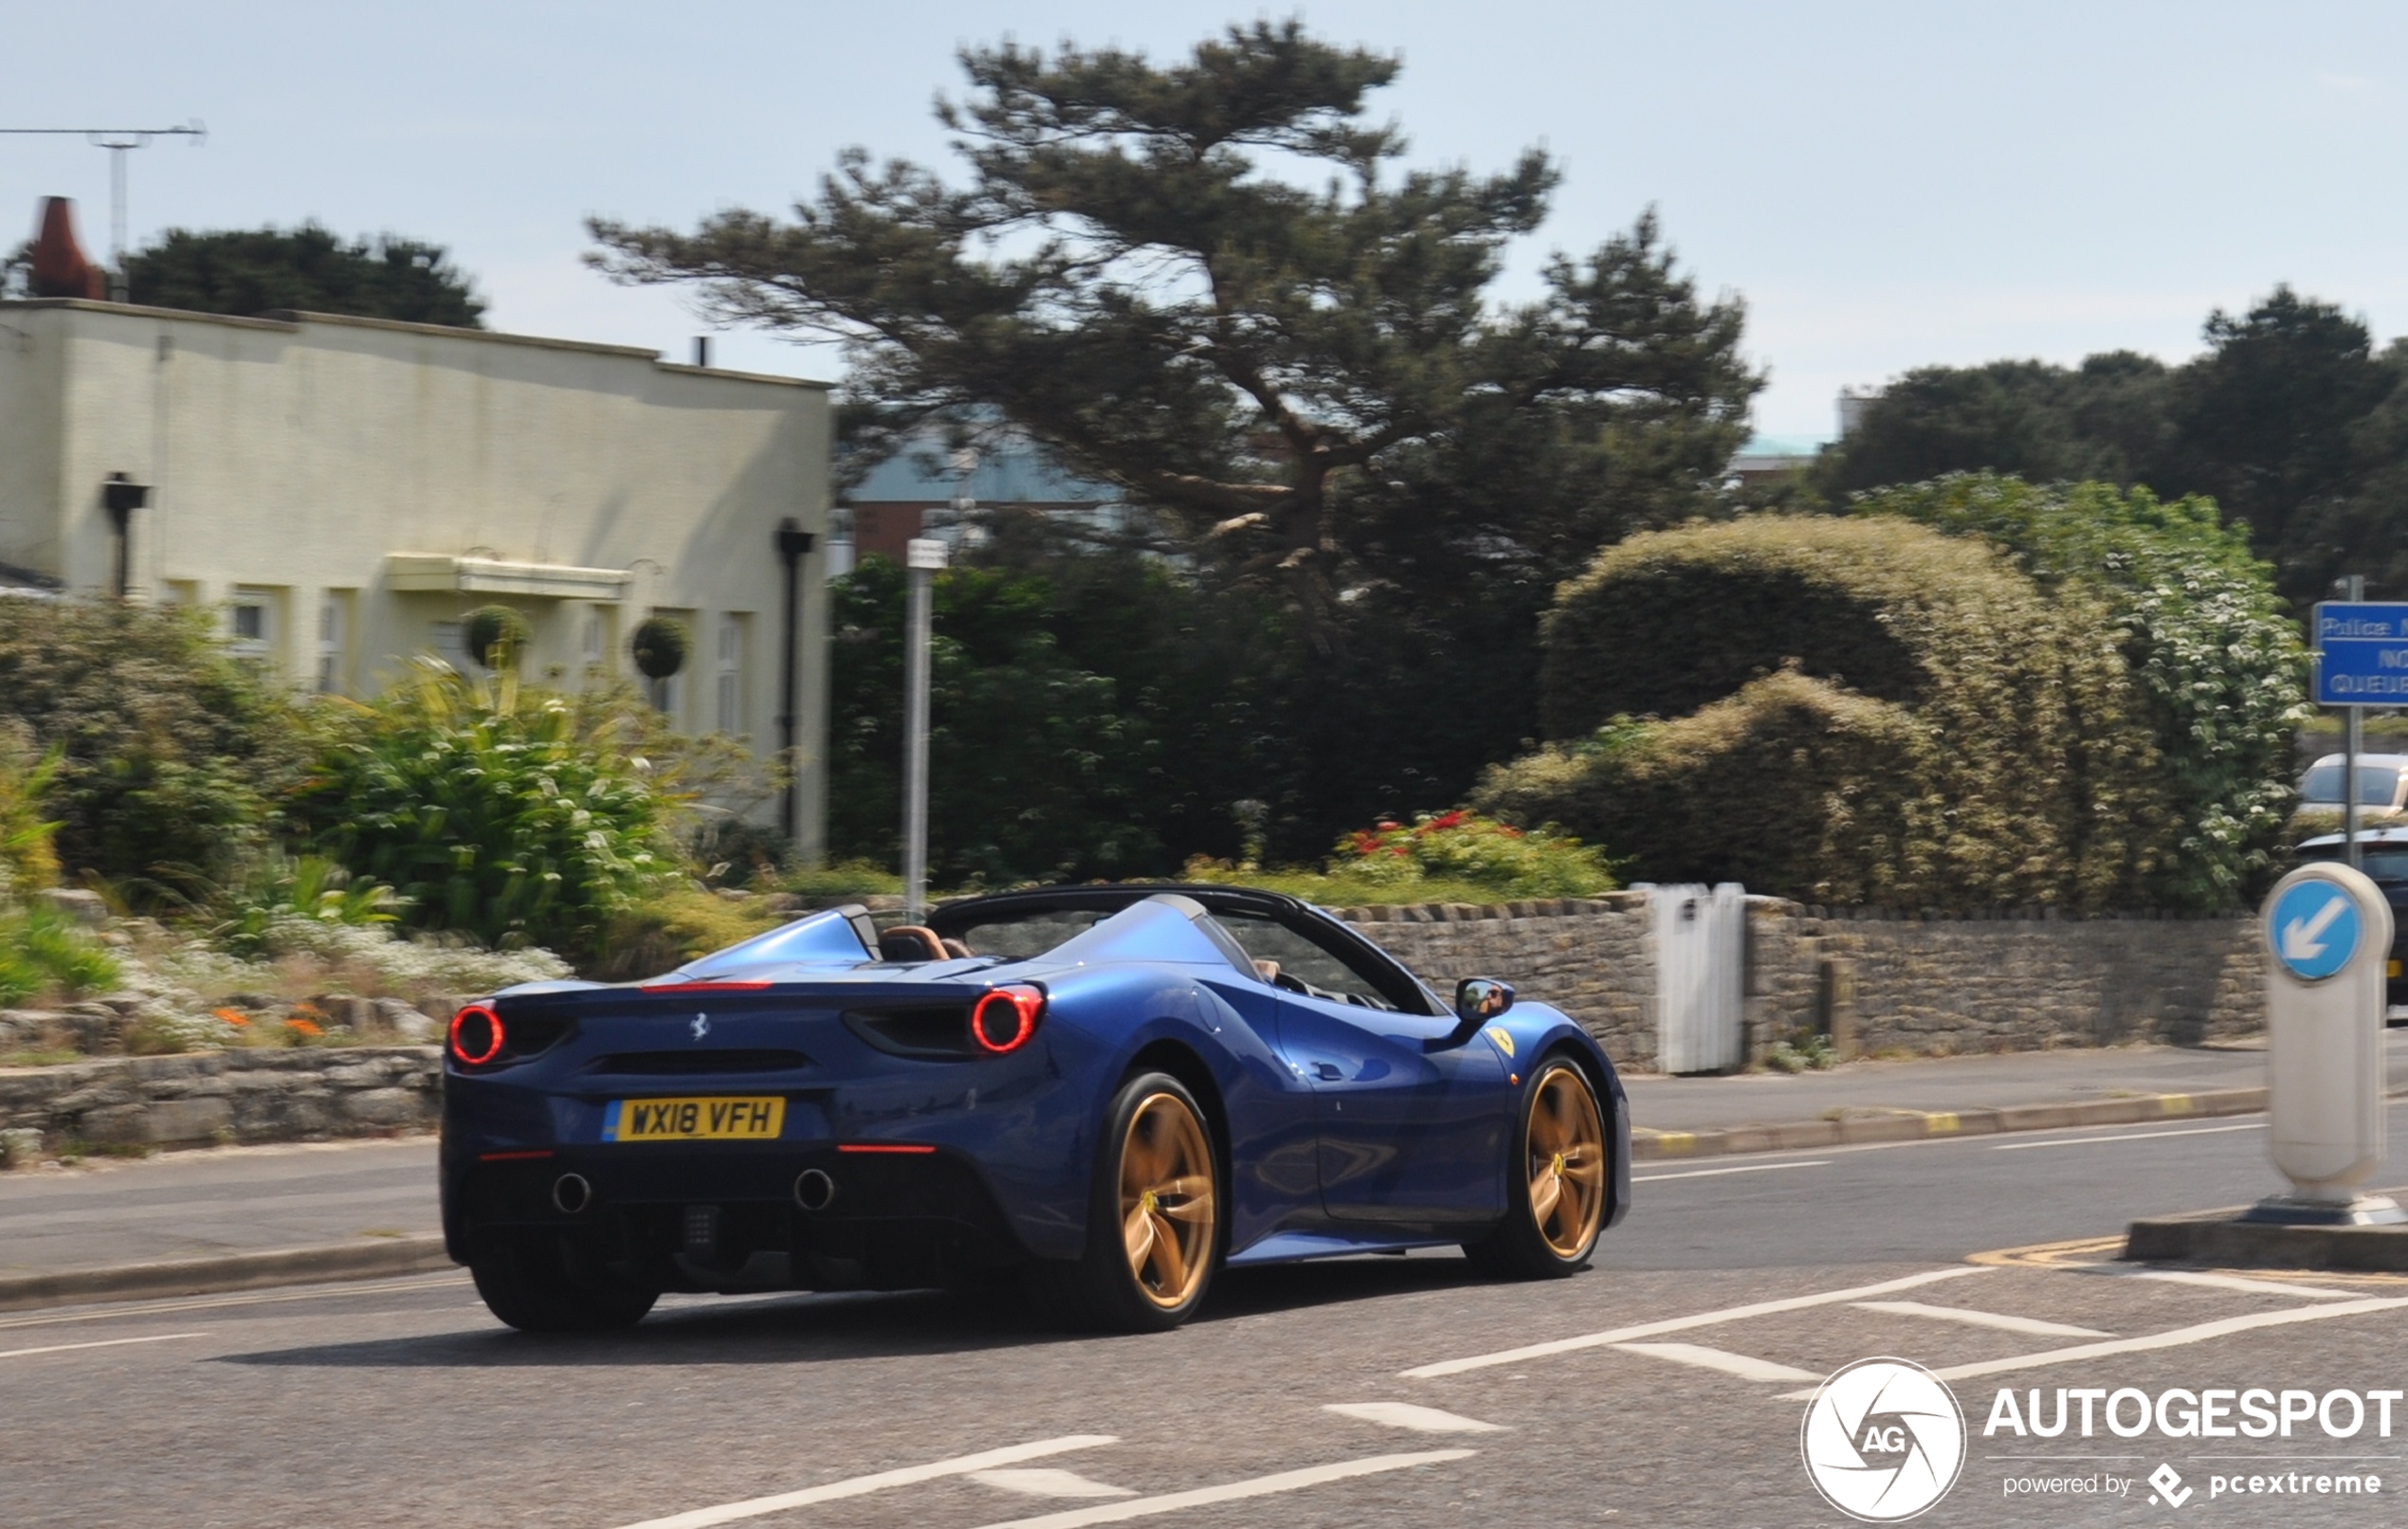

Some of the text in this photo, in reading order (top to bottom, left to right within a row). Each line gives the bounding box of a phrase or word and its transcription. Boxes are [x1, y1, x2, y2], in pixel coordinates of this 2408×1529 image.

[2322, 617, 2391, 636] Police
[631, 1102, 771, 1134] WX18 VFH
